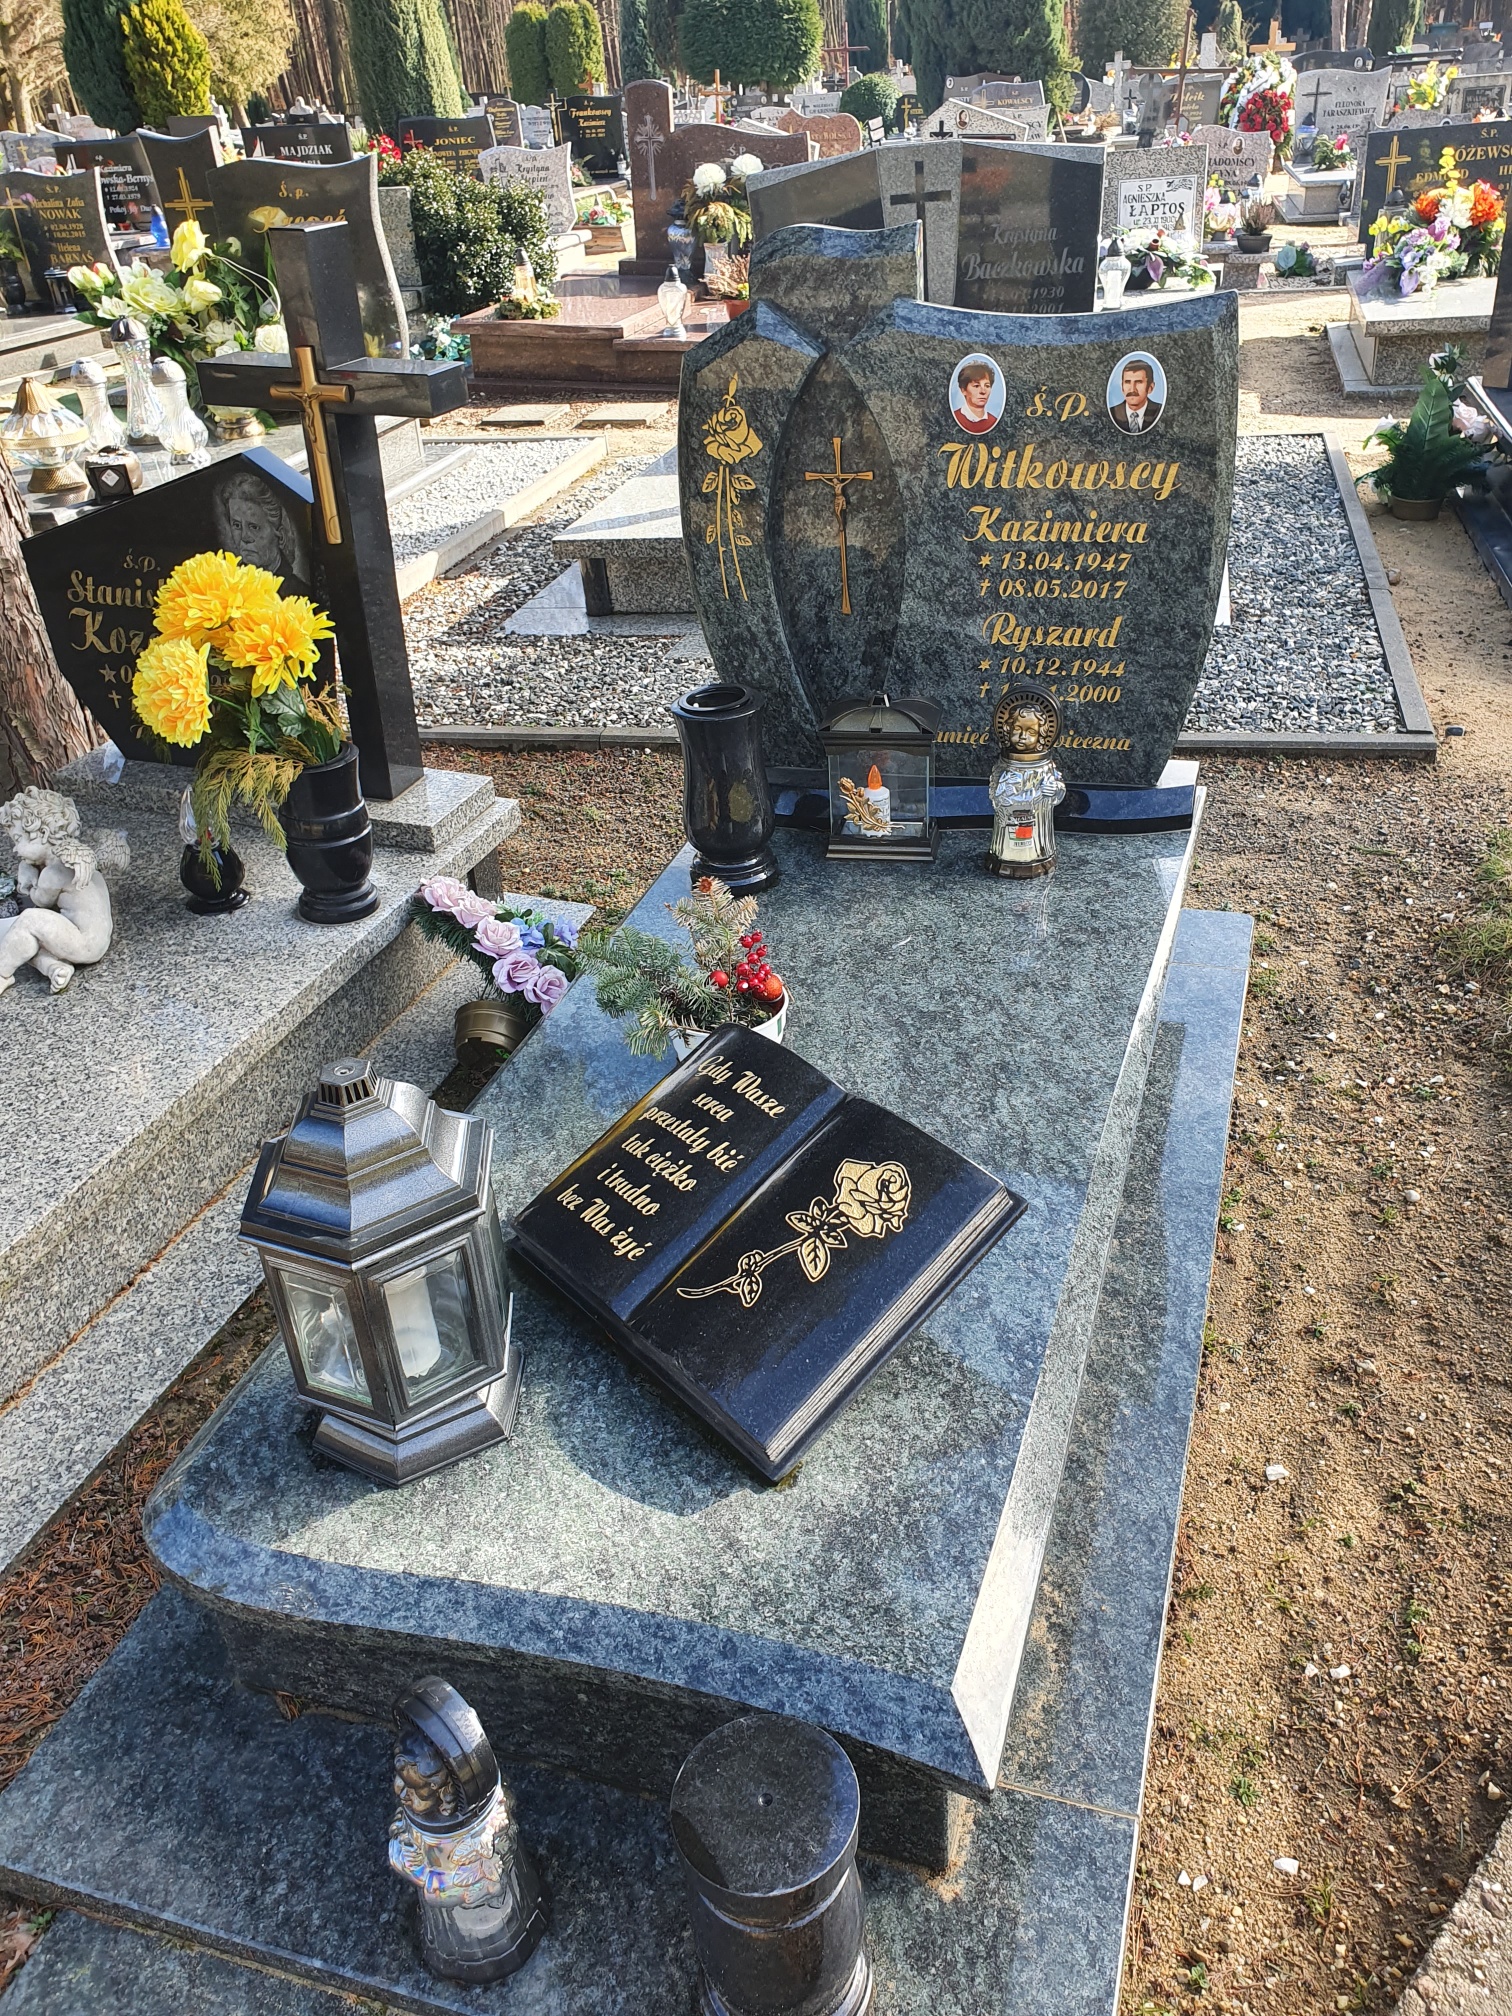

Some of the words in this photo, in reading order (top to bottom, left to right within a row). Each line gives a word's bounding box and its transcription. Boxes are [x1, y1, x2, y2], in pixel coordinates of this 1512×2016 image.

[280, 144, 333, 157] MAJDZIAK
[434, 136, 476, 146] JONIEC
[1454, 145, 1512, 162] ÓŻEWS
[1416, 168, 1469, 183] EDMD
[1123, 192, 1166, 204] AGNIESZKA
[39, 209, 82, 220] NOWAK
[1129, 202, 1185, 217] ŁAPTOS
[50, 250, 95, 263] BARNAŚ
[937, 442, 1182, 500] Witkowscy
[962, 505, 1150, 543] Kazimiera
[1000, 551, 1133, 573] 13.04.1947
[998, 578, 1129, 599] 08.05.2017
[68, 608, 161, 655] Koz
[982, 612, 1124, 653] Ryszard
[1000, 657, 1127, 678] 10.12.1944
[695, 1055, 734, 1085] Gdy
[731, 1070, 786, 1119] Wasze
[692, 1093, 735, 1123] serca
[638, 1106, 711, 1154] przestały
[706, 1141, 744, 1173] bić
[596, 1162, 618, 1181] i
[621, 1133, 655, 1160] tak
[645, 1150, 698, 1192] ciężko
[604, 1169, 661, 1216] trudno
[556, 1183, 584, 1211] bez
[579, 1197, 616, 1237] Was
[609, 1226, 653, 1262] żyć
